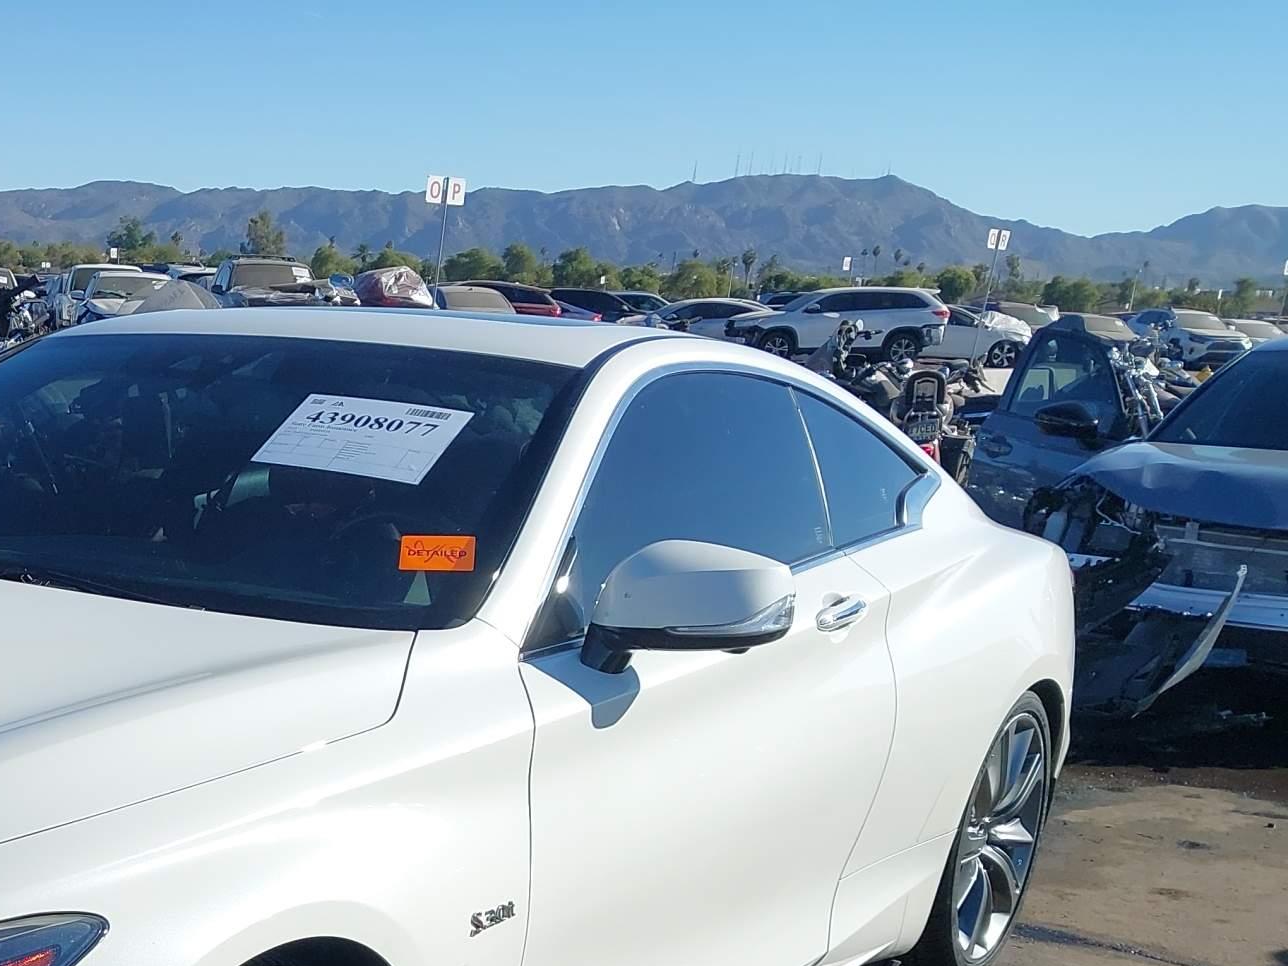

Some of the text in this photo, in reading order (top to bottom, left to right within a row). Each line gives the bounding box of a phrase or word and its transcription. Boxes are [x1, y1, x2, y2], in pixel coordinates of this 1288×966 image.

[452, 182, 461, 201] P
[305, 410, 440, 437] 43908077
[407, 549, 468, 559] DETAILED
